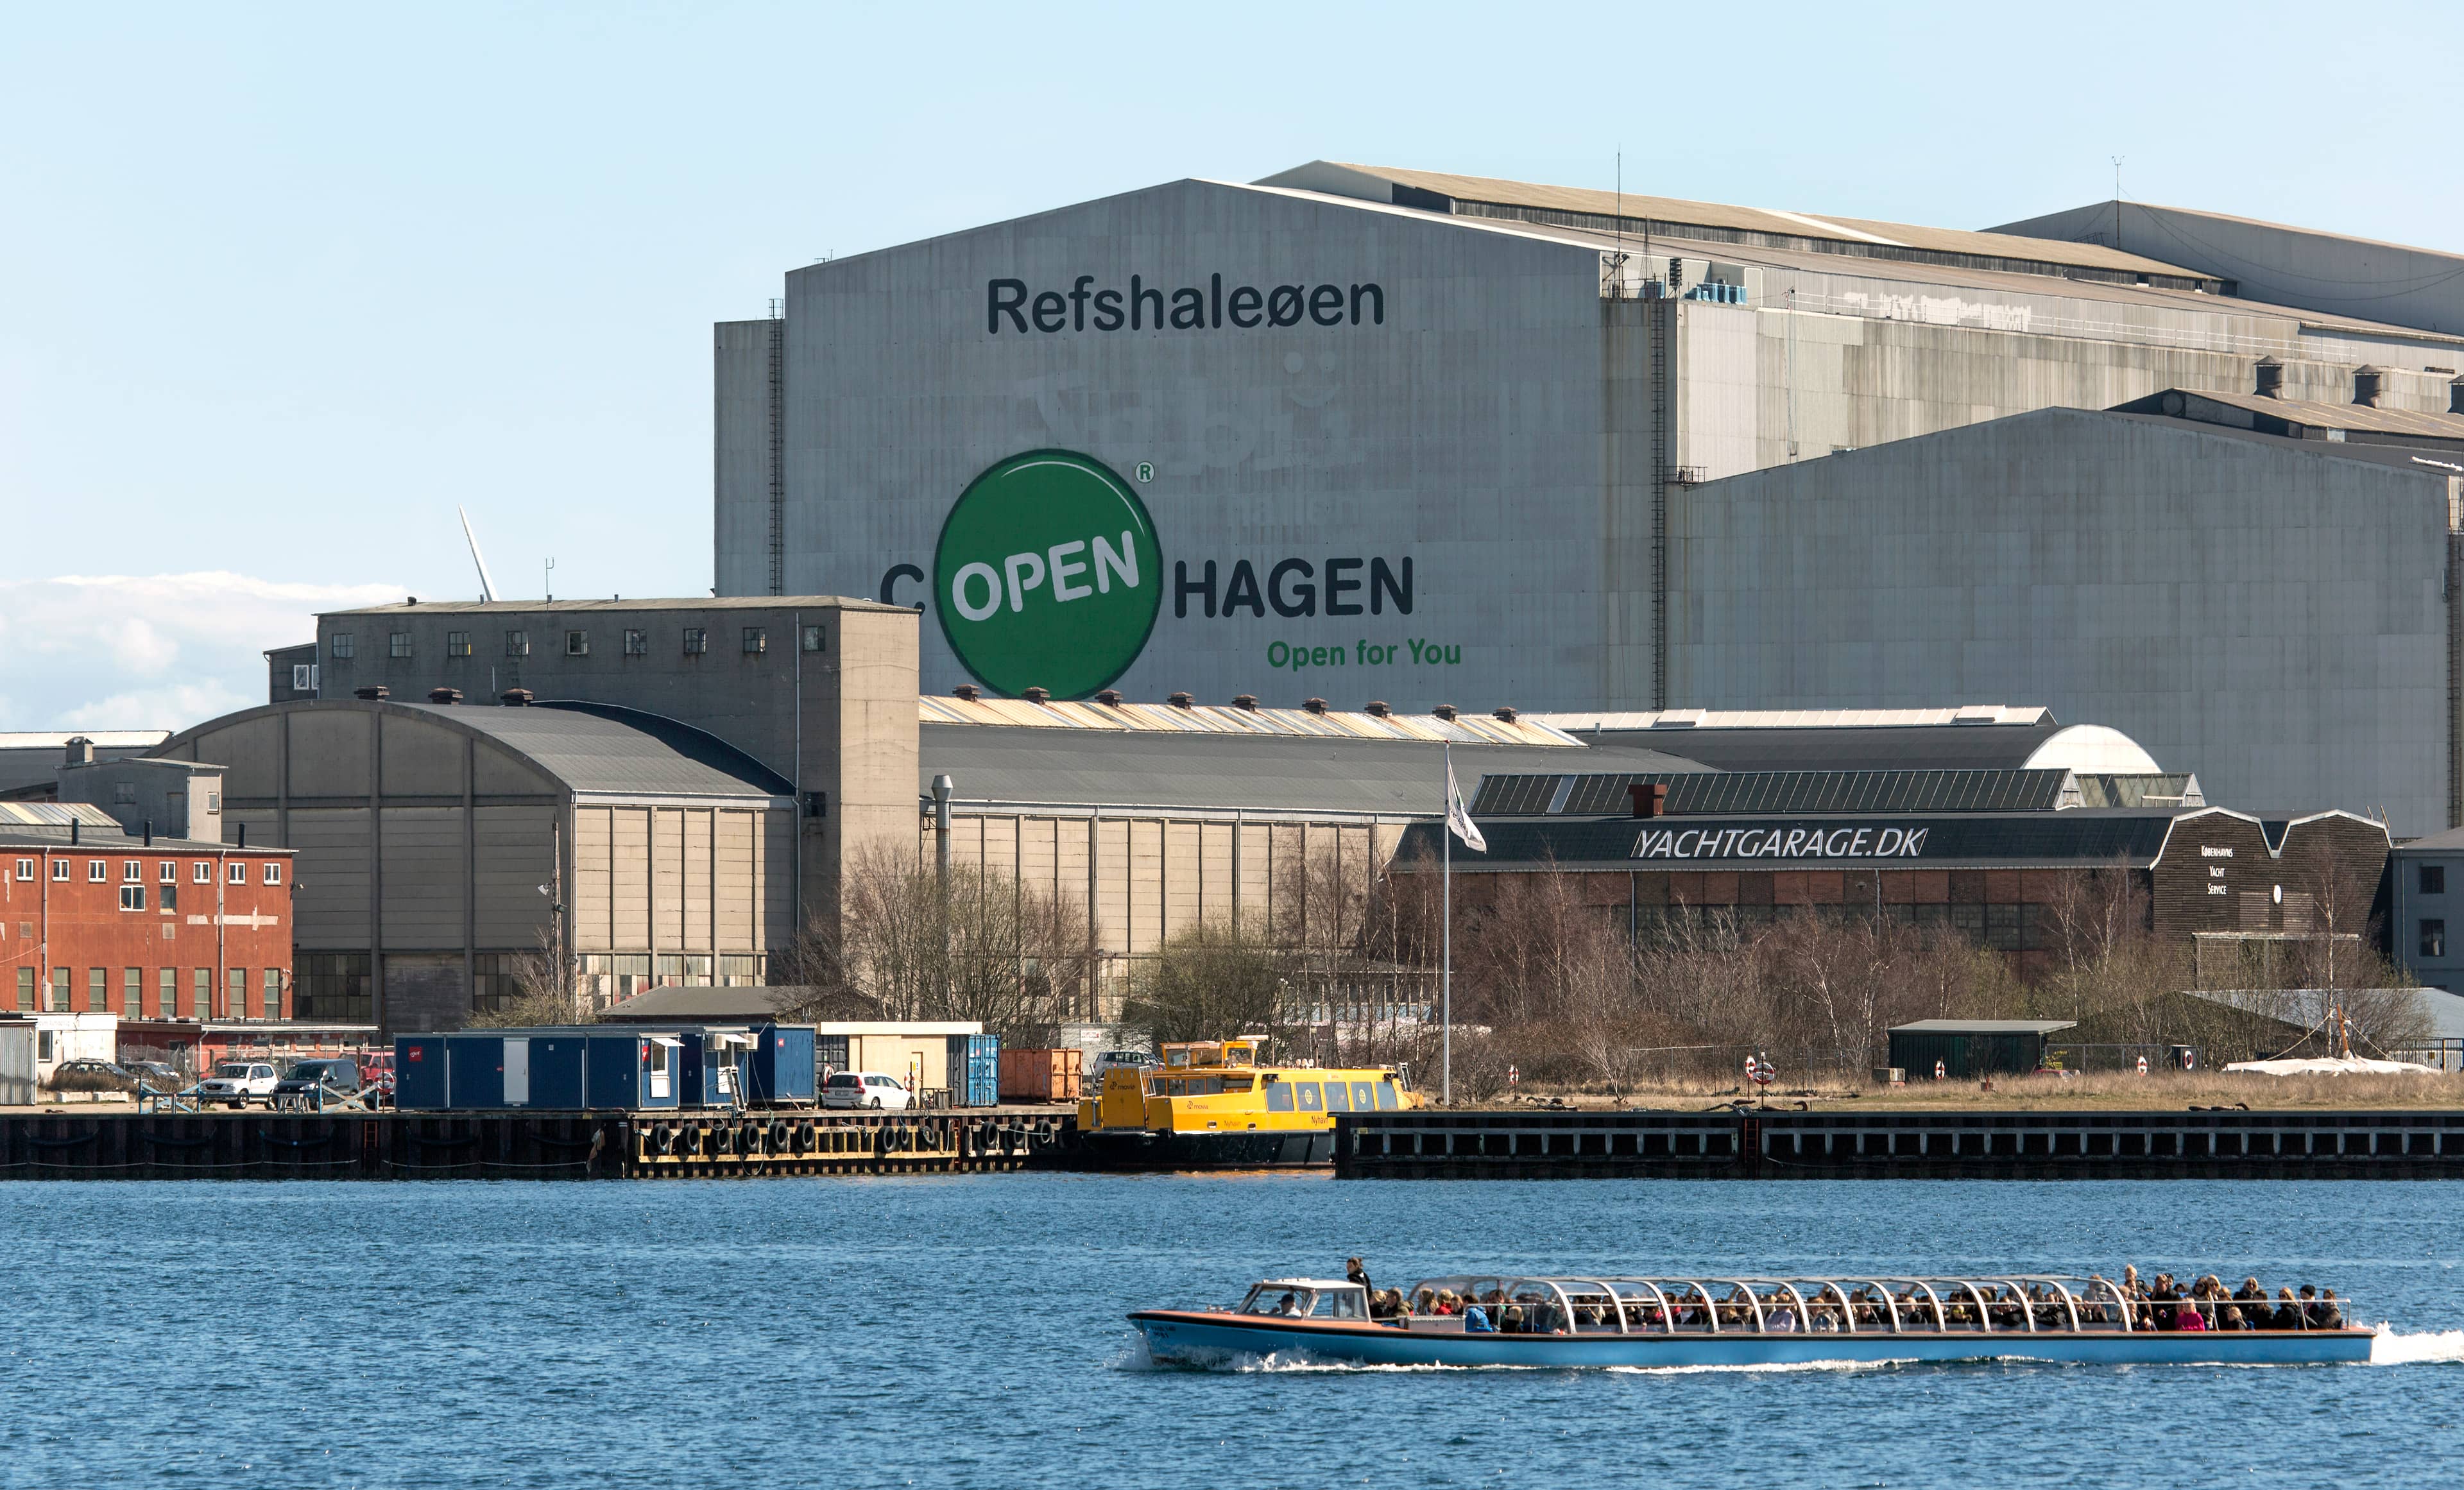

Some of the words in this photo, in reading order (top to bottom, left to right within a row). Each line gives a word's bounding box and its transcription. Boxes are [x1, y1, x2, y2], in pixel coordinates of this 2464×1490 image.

[988, 272, 1385, 335] Refshaleøen
[1267, 640, 1346, 672] Open
[1356, 639, 1398, 665] for
[1407, 638, 1461, 665] You
[1638, 827, 1927, 857] YACHTGARAGE.DK
